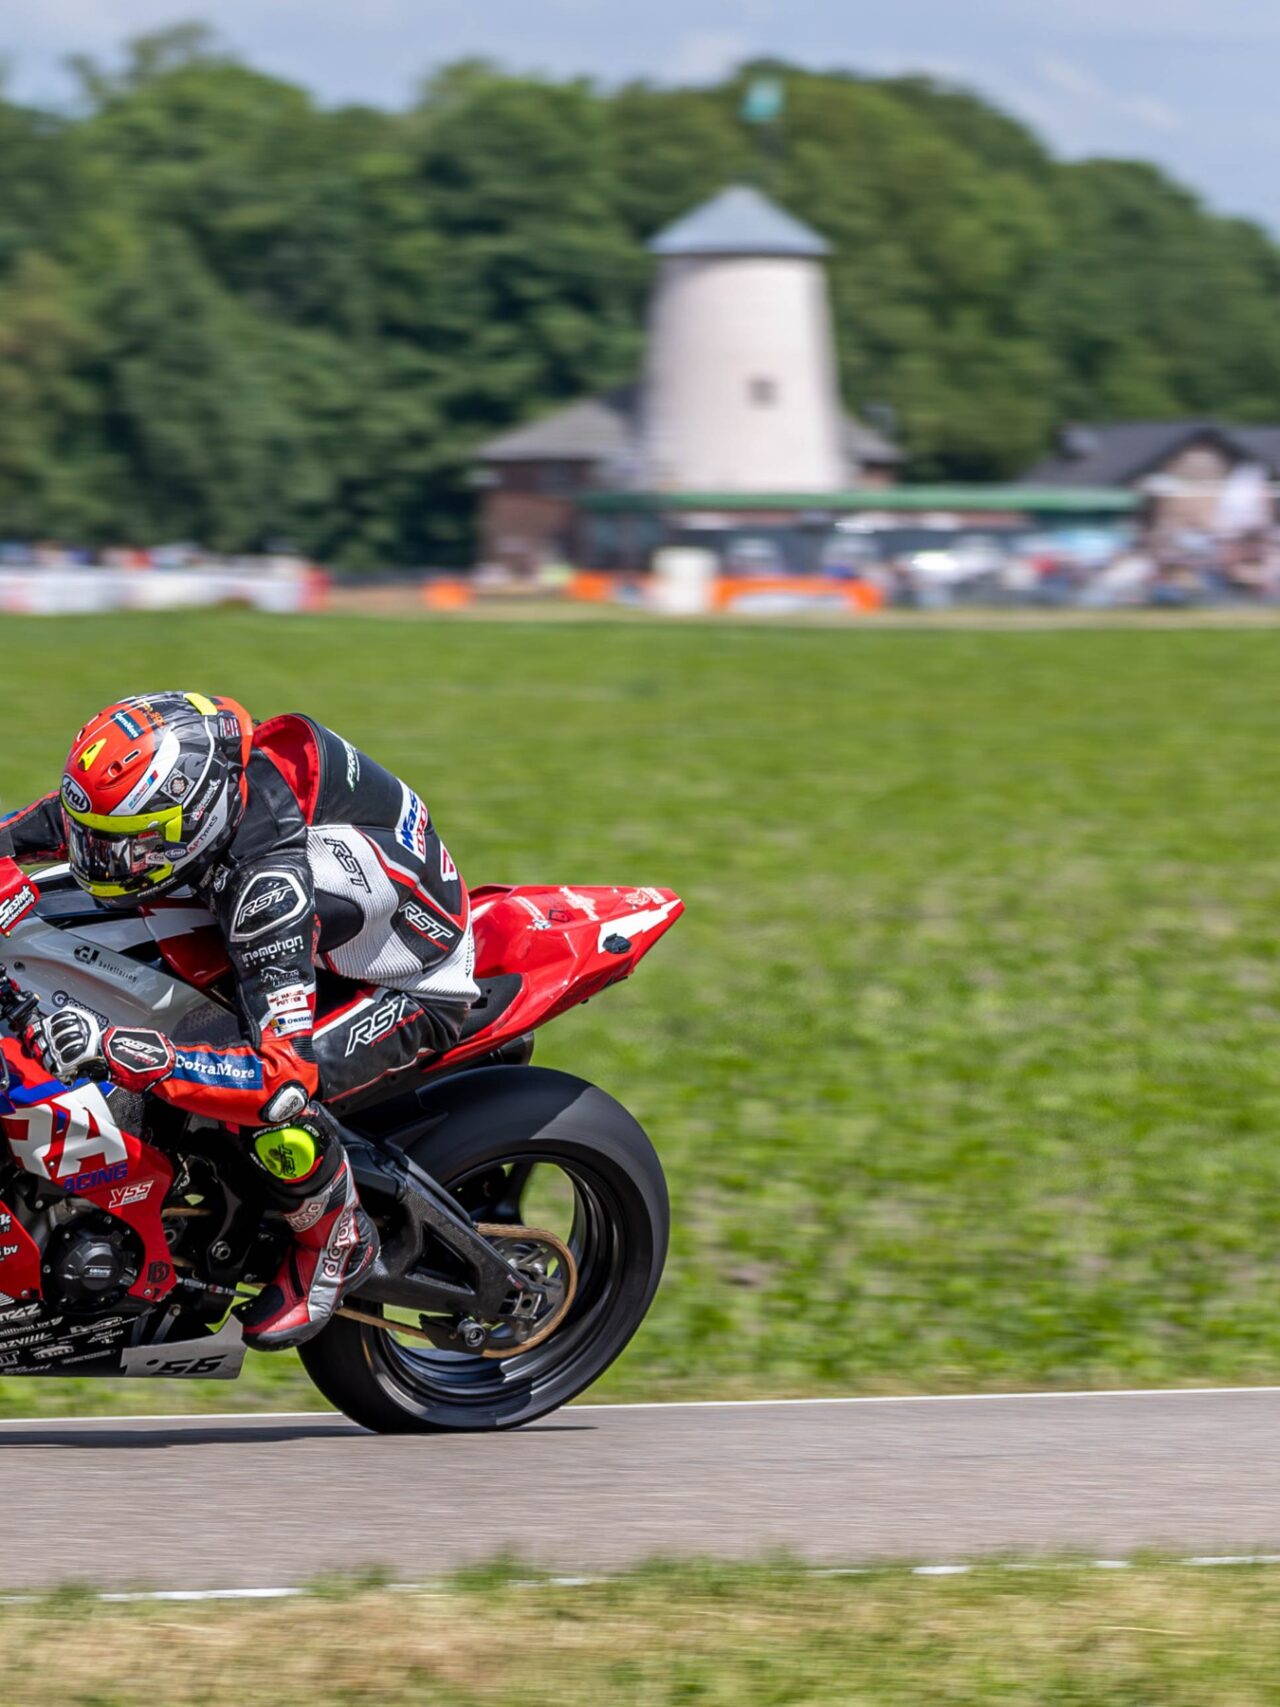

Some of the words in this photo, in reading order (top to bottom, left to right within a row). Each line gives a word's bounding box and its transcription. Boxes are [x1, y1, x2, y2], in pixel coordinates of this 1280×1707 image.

[61, 778, 87, 809] Arai
[323, 837, 372, 894] RST
[237, 885, 293, 928] RST
[398, 901, 454, 940] RST
[344, 991, 409, 1058] RST
[63, 1161, 128, 1193] ACING
[3, 1245, 19, 1256] bv
